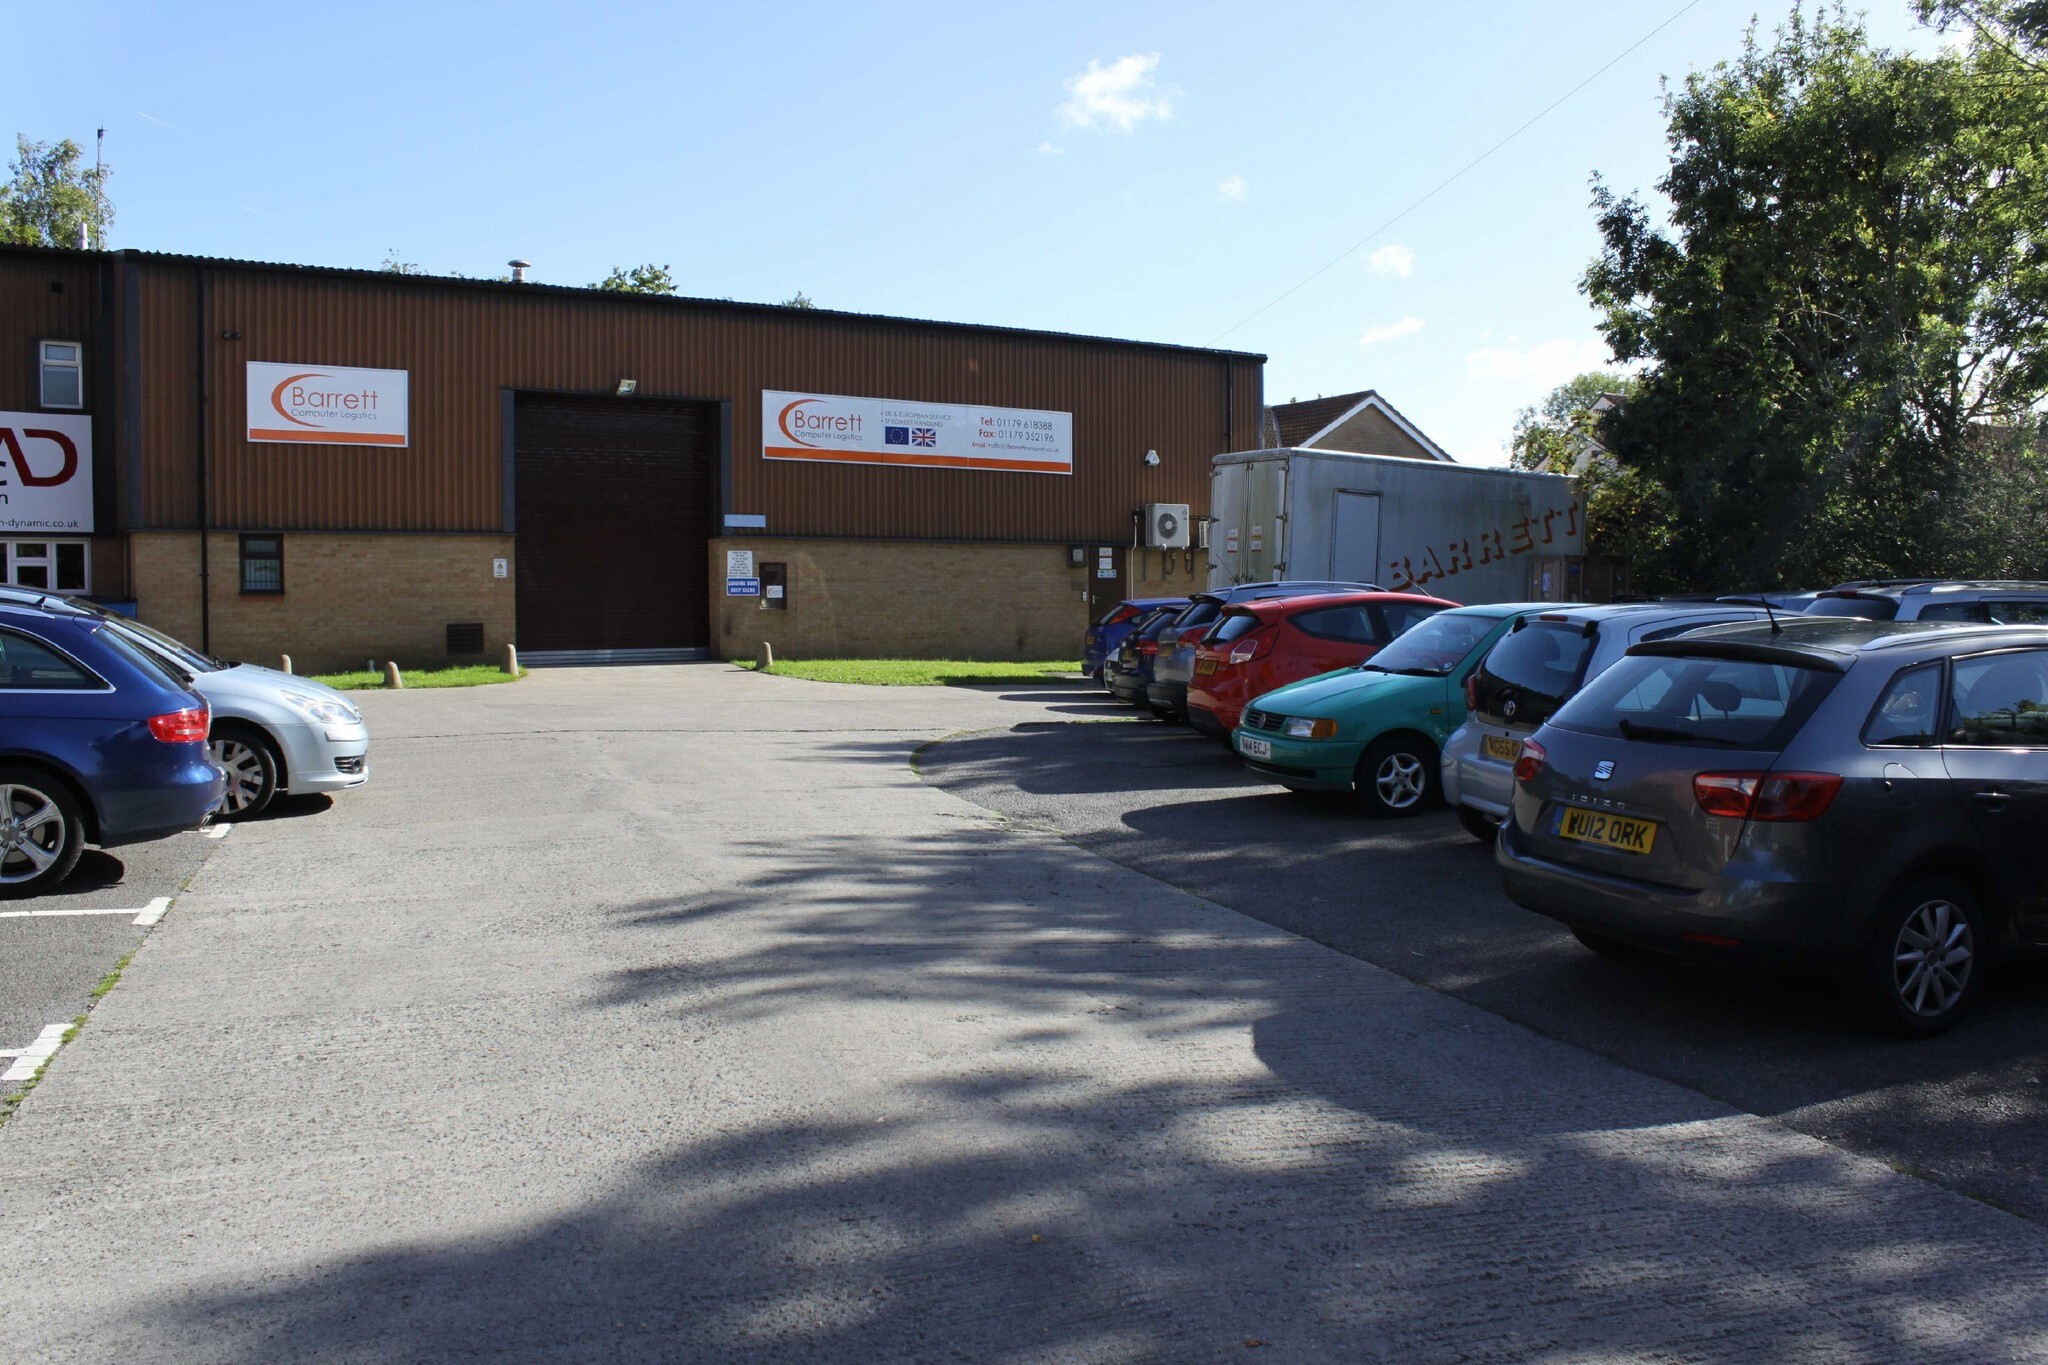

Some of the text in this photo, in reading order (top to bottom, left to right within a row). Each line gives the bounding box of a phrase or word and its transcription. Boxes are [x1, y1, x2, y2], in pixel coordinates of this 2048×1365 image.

[292, 386, 378, 410] Barrett
[291, 408, 377, 421] Computer Logistics
[794, 410, 863, 432] Barrett
[899, 411, 929, 419] EUROPEAN
[980, 416, 1053, 431] Tel: 01179 618388
[794, 429, 862, 442] Computer Logistics
[979, 428, 1055, 443] Fax: 01179 352196
[1386, 499, 1579, 592] BARRETT
[1608, 819, 1648, 849] ORK
